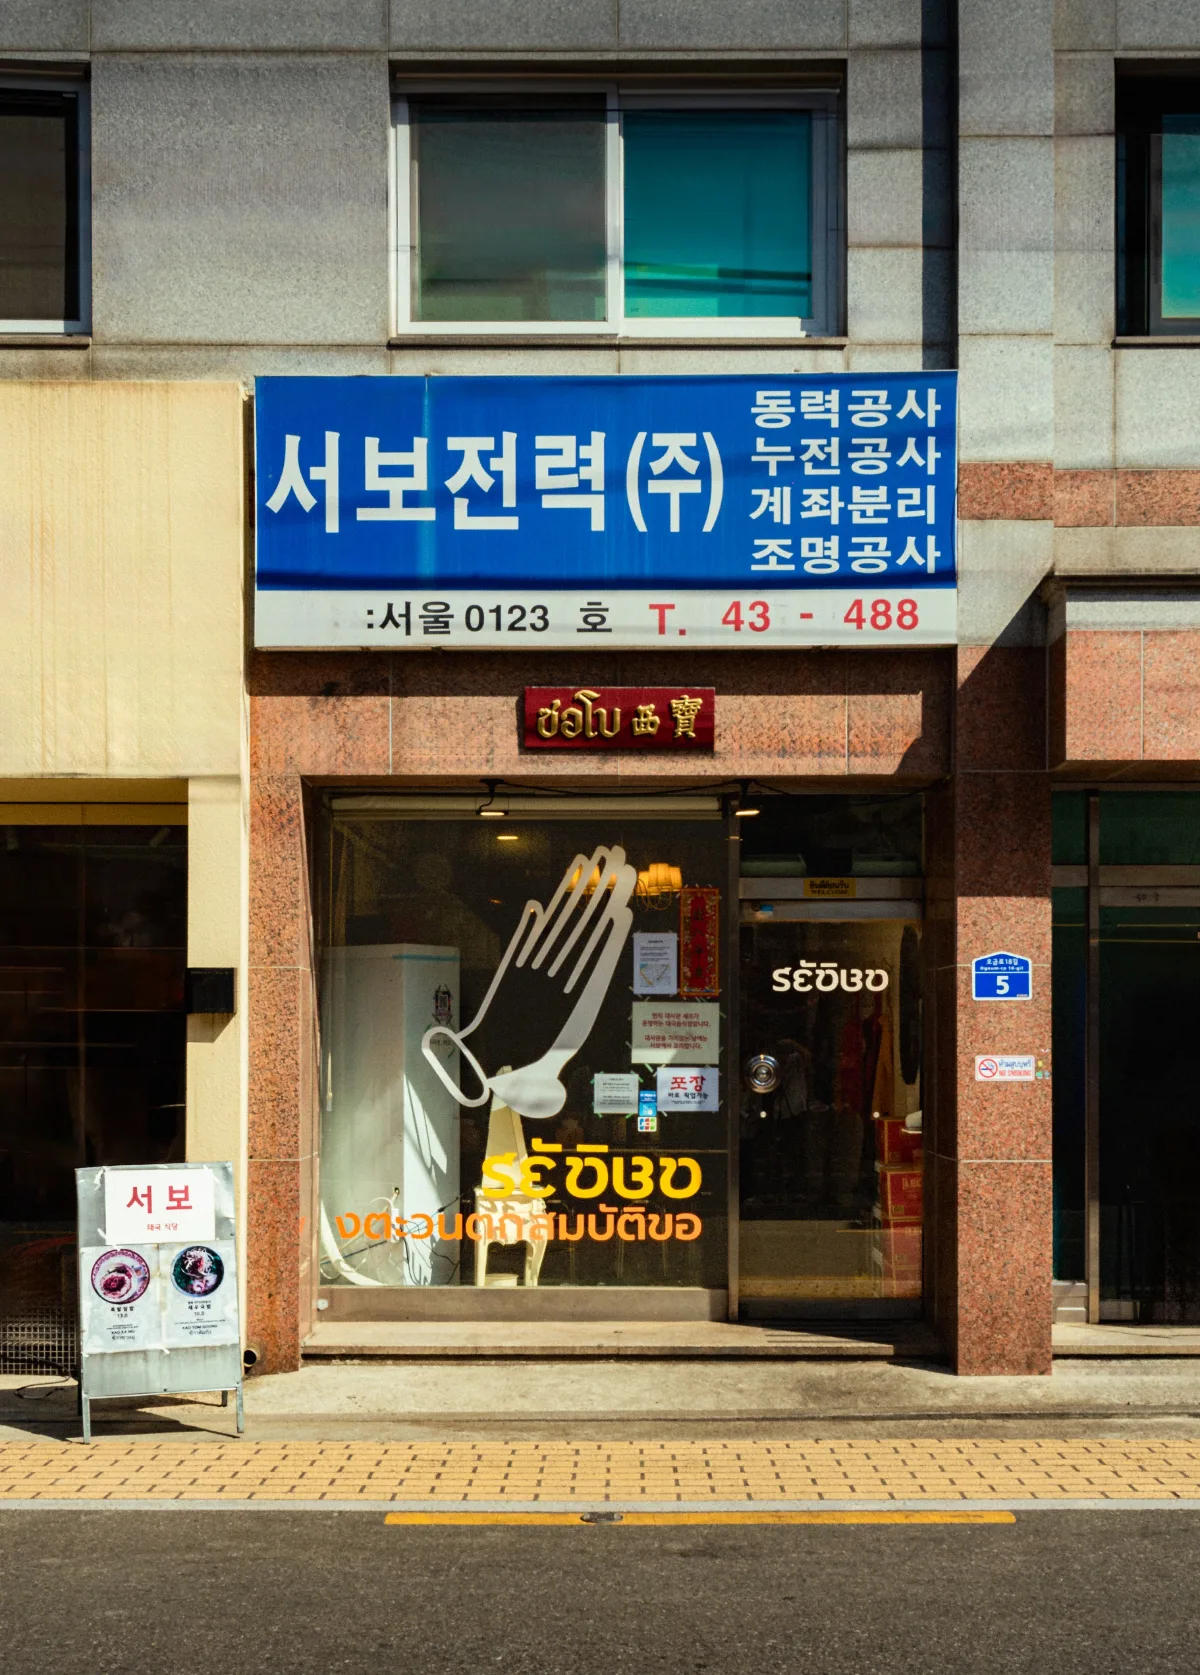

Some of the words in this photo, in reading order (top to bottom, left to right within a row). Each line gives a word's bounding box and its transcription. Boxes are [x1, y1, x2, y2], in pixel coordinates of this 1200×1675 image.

[750, 388, 941, 429] 동력공사
[750, 436, 941, 477] 누전공사
[265, 430, 724, 534] 서보전력(주)
[749, 484, 936, 527] 계좌분리
[750, 534, 941, 574] 조명공사
[576, 602, 613, 635] 호
[649, 603, 687, 636] T.
[721, 600, 770, 632] 43
[843, 598, 919, 630] 488
[996, 975, 1010, 995] 5
[670, 1075, 707, 1092] 포장
[146, 1223, 161, 1231] 태국
[164, 1222, 178, 1231] 식당
